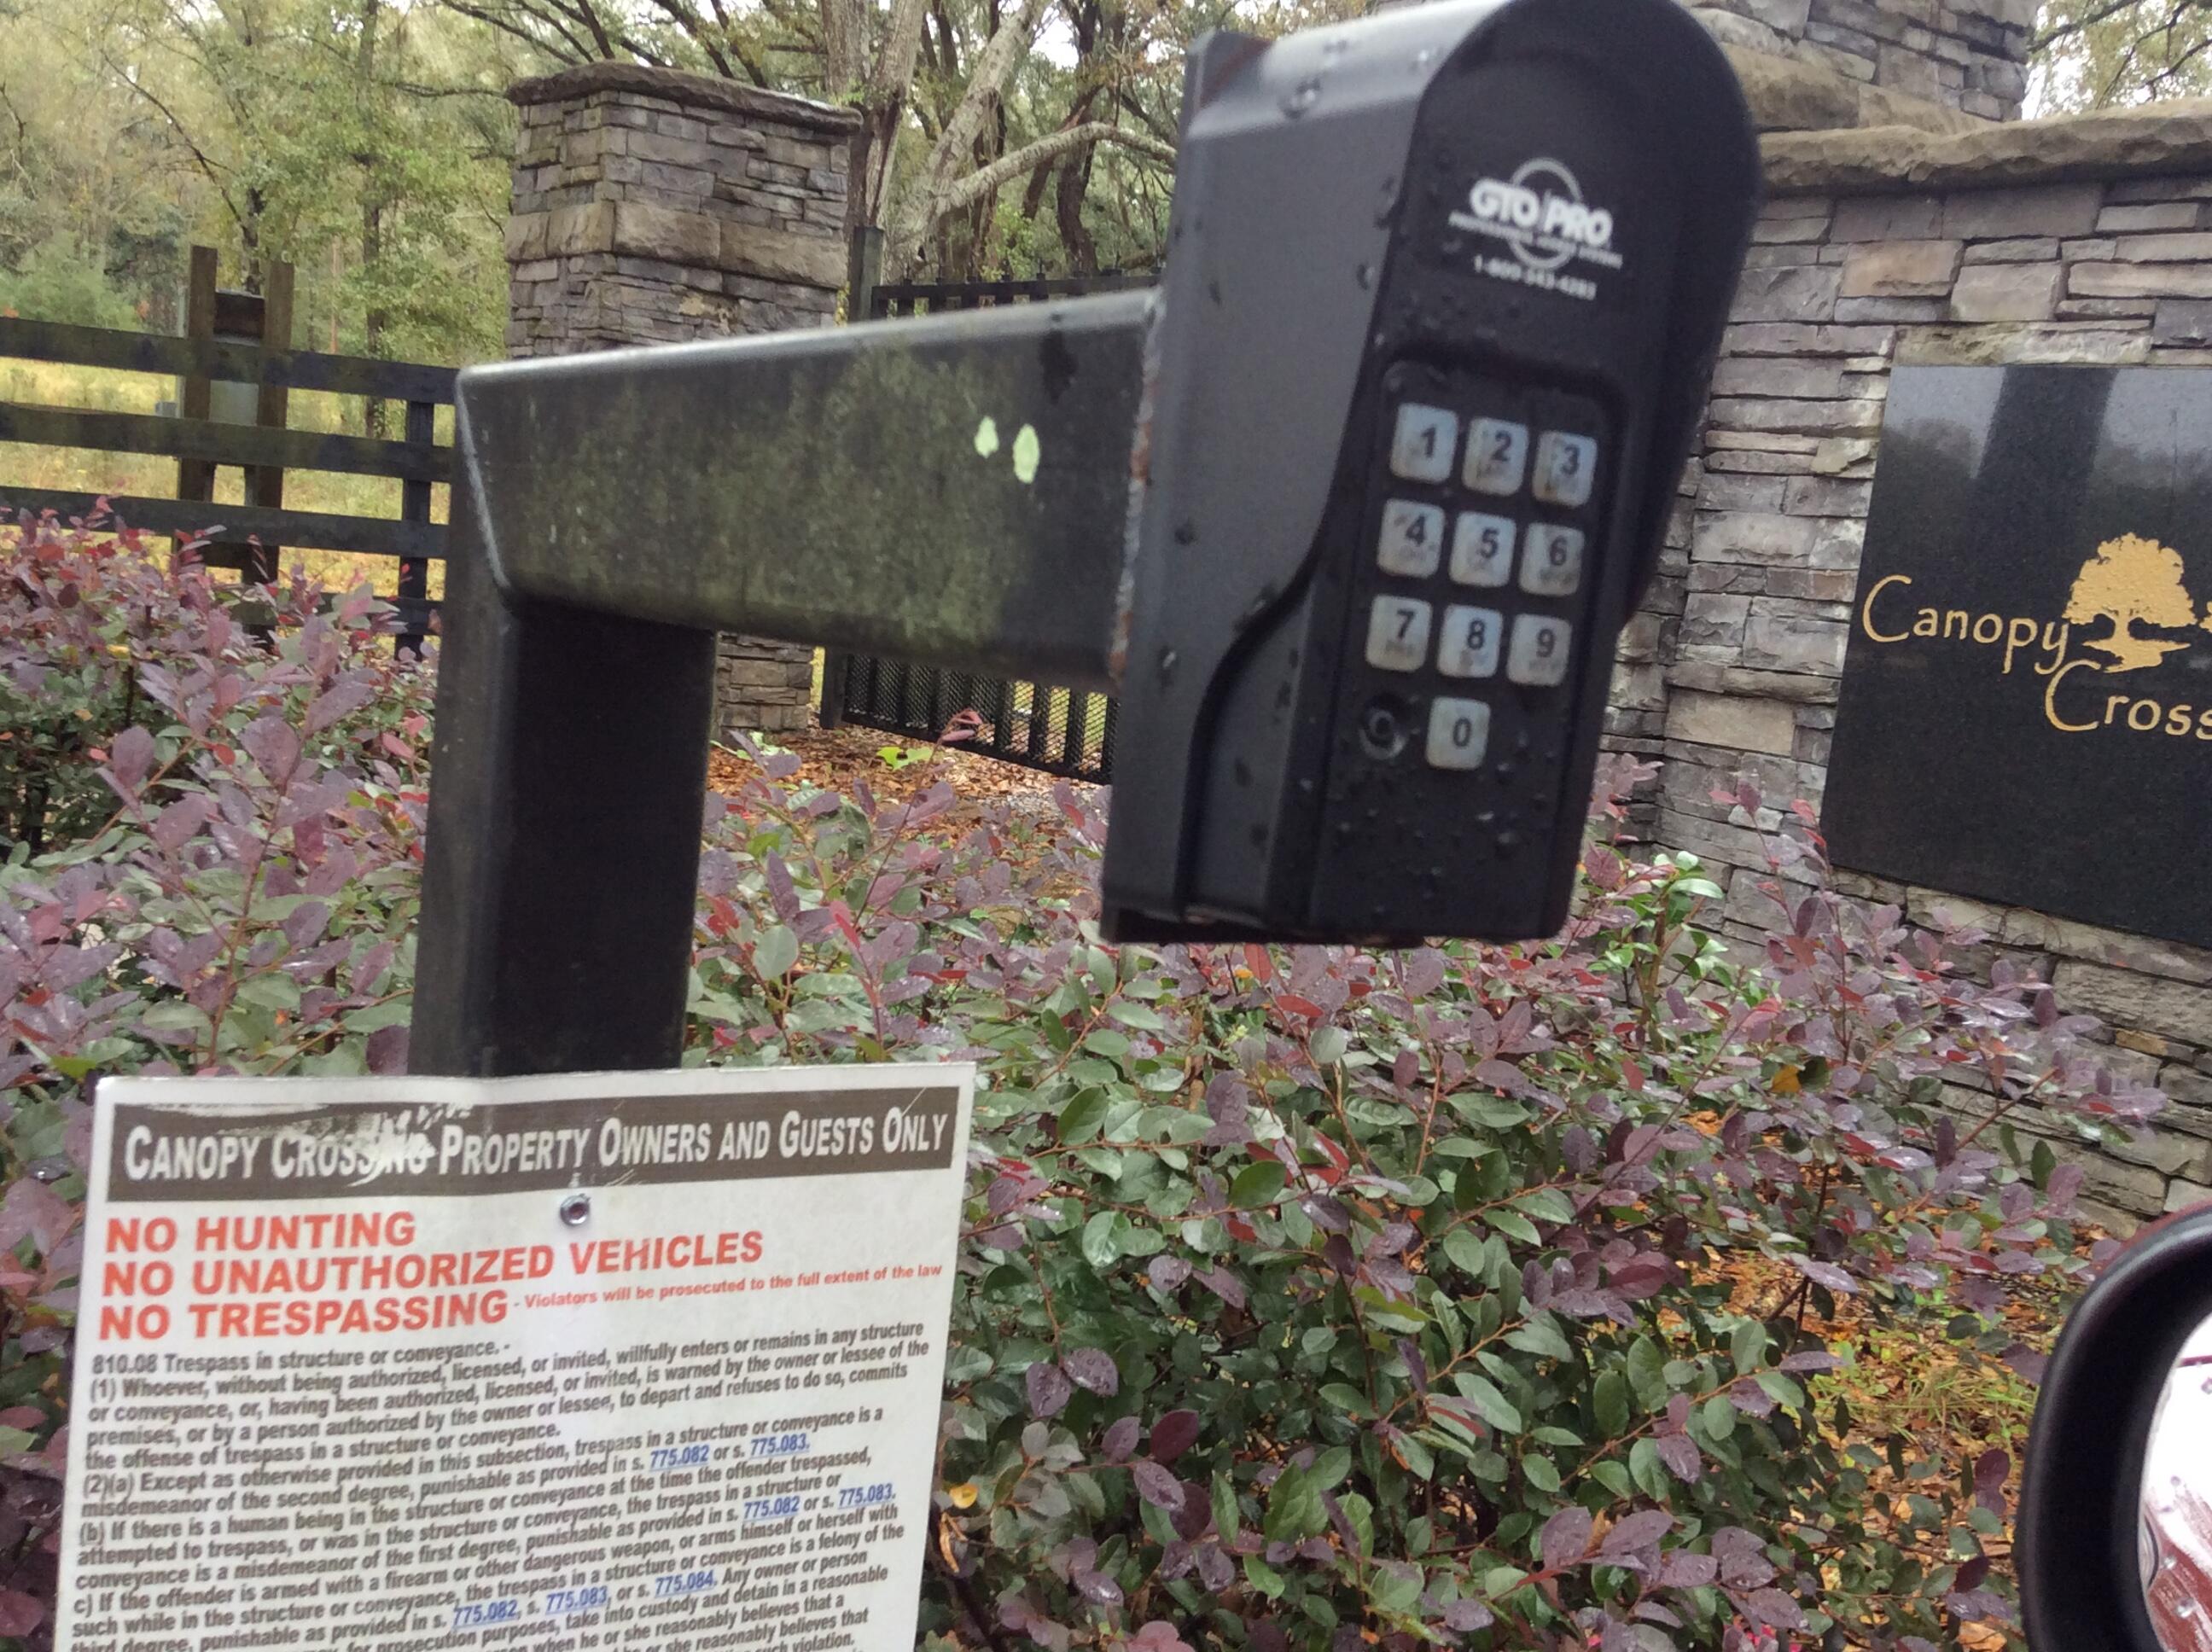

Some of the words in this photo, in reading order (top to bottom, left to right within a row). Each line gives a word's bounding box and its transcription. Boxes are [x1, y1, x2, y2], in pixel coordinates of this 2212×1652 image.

[1470, 177, 1540, 228] GTO
[1543, 195, 1613, 247] PRO
[1421, 425, 1436, 458] 1
[1493, 430, 1511, 462] 2
[1561, 444, 1579, 475] 3
[1406, 515, 1426, 545] 4
[1481, 528, 1499, 558] 5
[1549, 537, 1567, 567] 6
[1397, 608, 1415, 639] 7
[1466, 619, 1486, 649] 8
[1537, 628, 1555, 658] 9
[1862, 574, 2069, 675] Canopy
[1453, 718, 1471, 747] 0
[125, 1125, 260, 1180] CANOPY
[439, 1122, 591, 1174] PROPERTY
[598, 1117, 710, 1166] OWNERS
[718, 1120, 770, 1160] AND
[779, 1110, 873, 1158] GUESTS
[882, 1106, 948, 1153] ONLY
[103, 1260, 175, 1297] NO
[192, 1244, 554, 1295] UNAUTHORIZED
[568, 1230, 764, 1276] VEHICLES
[107, 1217, 178, 1253] NO
[195, 1211, 416, 1252] HUNTING
[99, 1305, 170, 1341] NO
[188, 1289, 508, 1338] TRESPASSING
[524, 1291, 598, 1309] Violators
[602, 1288, 631, 1302] will
[635, 1286, 654, 1300] be
[660, 1277, 746, 1303] prosecuted
[749, 1277, 765, 1290] to
[770, 1275, 794, 1288] the
[797, 1271, 820, 1287] full
[824, 1268, 870, 1283] extent
[874, 1266, 888, 1281] of
[892, 1265, 914, 1279] the
[917, 1263, 943, 1277] law
[92, 1355, 160, 1374] 810.08
[166, 1355, 251, 1376] Trespass
[278, 1351, 365, 1369] structure
[393, 1343, 498, 1364] conveyance.
[114, 1405, 231, 1424] conveyance,
[269, 1397, 330, 1417] having
[335, 1395, 380, 1412] been
[384, 1385, 478, 1409] authorized,
[485, 1377, 556, 1400] licensed,
[584, 1369, 640, 1390] invited,
[665, 1360, 723, 1382] warned
[775, 1354, 818, 1370] owner
[841, 1347, 886, 1363] lessee
[122, 1379, 207, 1399] Whoever,
[216, 1376, 288, 1395] without
[292, 1373, 344, 1393] being
[348, 1365, 445, 1388] authorized,
[452, 1358, 525, 1381] licensed,
[553, 1350, 609, 1371] invited,
[681, 1341, 731, 1358] enters
[753, 1331, 812, 1351] remains
[860, 1323, 923, 1341] structure
[86, 1427, 179, 1448] premises,
[256, 1424, 321, 1445] person
[326, 1412, 421, 1436] authorized
[482, 1405, 533, 1422] owner
[558, 1398, 614, 1415] lessee,
[640, 1386, 691, 1408] depart
[726, 1378, 781, 1396] refuses
[849, 1364, 908, 1383] commits
[81, 1498, 210, 1515] misdemeanor
[276, 1486, 344, 1508] second
[347, 1485, 411, 1505] degree,
[419, 1471, 512, 1500] punishable
[539, 1458, 609, 1486] provided
[649, 1446, 710, 1469] 775.082
[750, 1433, 809, 1456] 775.083.
[122, 1450, 195, 1469] offense
[224, 1448, 306, 1467] trespass
[349, 1438, 432, 1457] structure
[458, 1424, 560, 1448] conveyance.
[140, 1473, 208, 1494] Except
[240, 1466, 332, 1487] otherwise
[336, 1457, 415, 1485] provided
[439, 1452, 472, 1471] this
[476, 1444, 568, 1468] subsection,
[575, 1437, 643, 1457] trespass
[679, 1424, 748, 1444] structure
[771, 1412, 855, 1433] conveyance
[78, 1543, 179, 1567] attempted
[208, 1541, 291, 1561] trespass,
[419, 1520, 498, 1540] structure
[523, 1504, 620, 1528] conveyance,
[656, 1491, 721, 1511] trespass
[756, 1477, 823, 1498] structure
[131, 1521, 183, 1539] there
[227, 1517, 290, 1534] human
[294, 1511, 345, 1531] being
[405, 1499, 486, 1520] structure
[510, 1485, 606, 1508] conveyance
[660, 1472, 694, 1489] time
[726, 1459, 786, 1480] offender
[790, 1447, 870, 1472] trespassed,
[76, 1570, 190, 1590] conveyance
[234, 1557, 357, 1580] misdemeanor
[418, 1544, 454, 1562] first
[458, 1539, 519, 1560] degree,
[526, 1523, 613, 1554] punishable
[638, 1509, 706, 1539] provided
[742, 1496, 801, 1520] 775.082
[838, 1483, 895, 1506] 775.083.
[156, 1587, 234, 1608] offender
[262, 1579, 322, 1601] armed
[325, 1574, 365, 1595] with
[385, 1569, 449, 1589] firearm
[474, 1558, 518, 1578] other
[523, 1549, 607, 1572] dangerous
[611, 1539, 673, 1560] weapon,
[699, 1530, 736, 1547] arms
[741, 1518, 795, 1541] himself
[816, 1508, 864, 1530] herself
[869, 1503, 899, 1522] with
[73, 1616, 120, 1635] such
[124, 1614, 177, 1633] while
[240, 1605, 325, 1626] structure
[353, 1591, 460, 1614] conveyance,
[498, 1575, 568, 1597] trespass
[605, 1560, 677, 1582] structure
[700, 1544, 786, 1568] conveyance
[818, 1532, 861, 1550] felony
[199, 1627, 300, 1652] punishable
[330, 1614, 409, 1644] provided
[453, 1600, 521, 1626] 775.082,
[546, 1586, 611, 1612] 775.083,
[655, 1570, 719, 1595] 775.084.
[754, 1562, 798, 1579] owner
[819, 1552, 868, 1573] person
[481, 1620, 558, 1647] purposes,
[566, 1610, 600, 1631] take
[604, 1606, 635, 1624] into
[638, 1595, 698, 1619] custody
[733, 1582, 779, 1603] detain
[812, 1565, 888, 1591] reasonable
[655, 1609, 736, 1637] reasonably
[741, 1603, 800, 1623] believes
[804, 1594, 833, 1613] that
[696, 1624, 776, 1651] reasonably
[780, 1616, 837, 1637] believes
[841, 1608, 870, 1626] that
